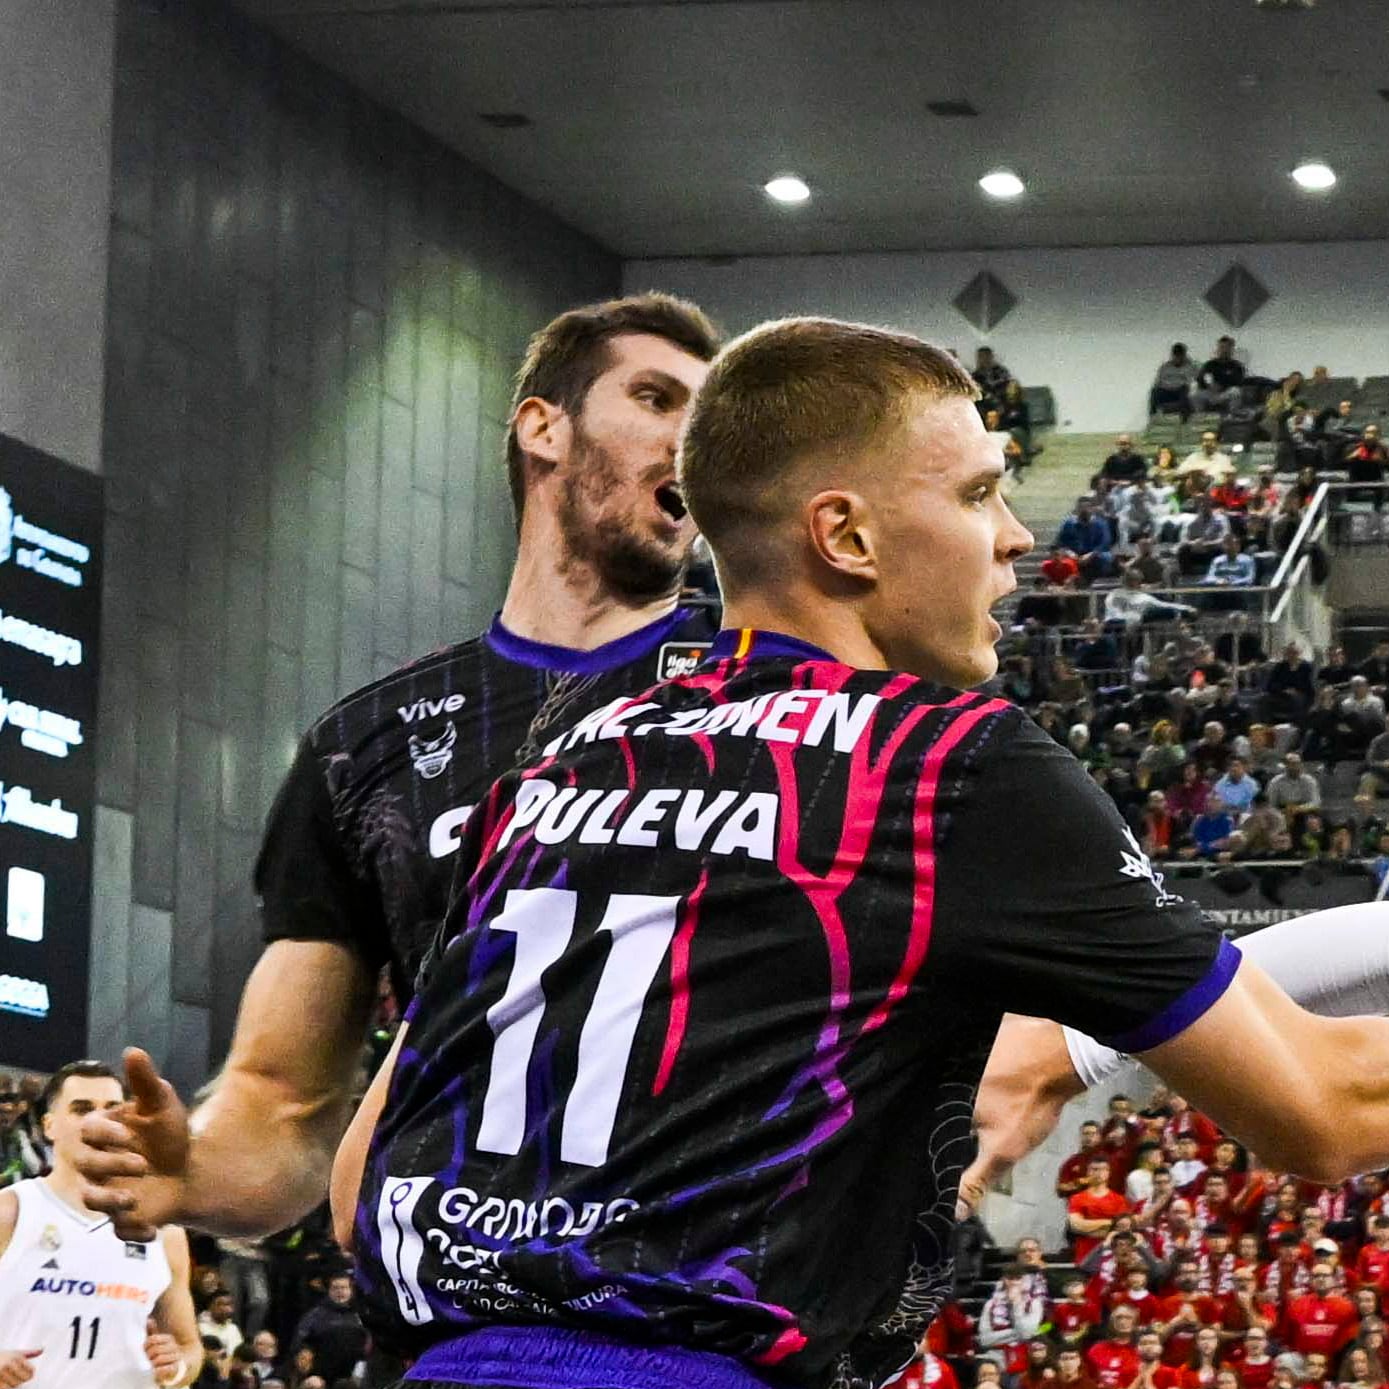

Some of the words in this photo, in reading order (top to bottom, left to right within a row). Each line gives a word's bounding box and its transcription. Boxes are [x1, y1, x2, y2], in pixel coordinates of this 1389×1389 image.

[398, 693, 466, 723] vive
[497, 779, 779, 861] PULEVA
[476, 887, 683, 1167] 11
[69, 1316, 101, 1360] 11
